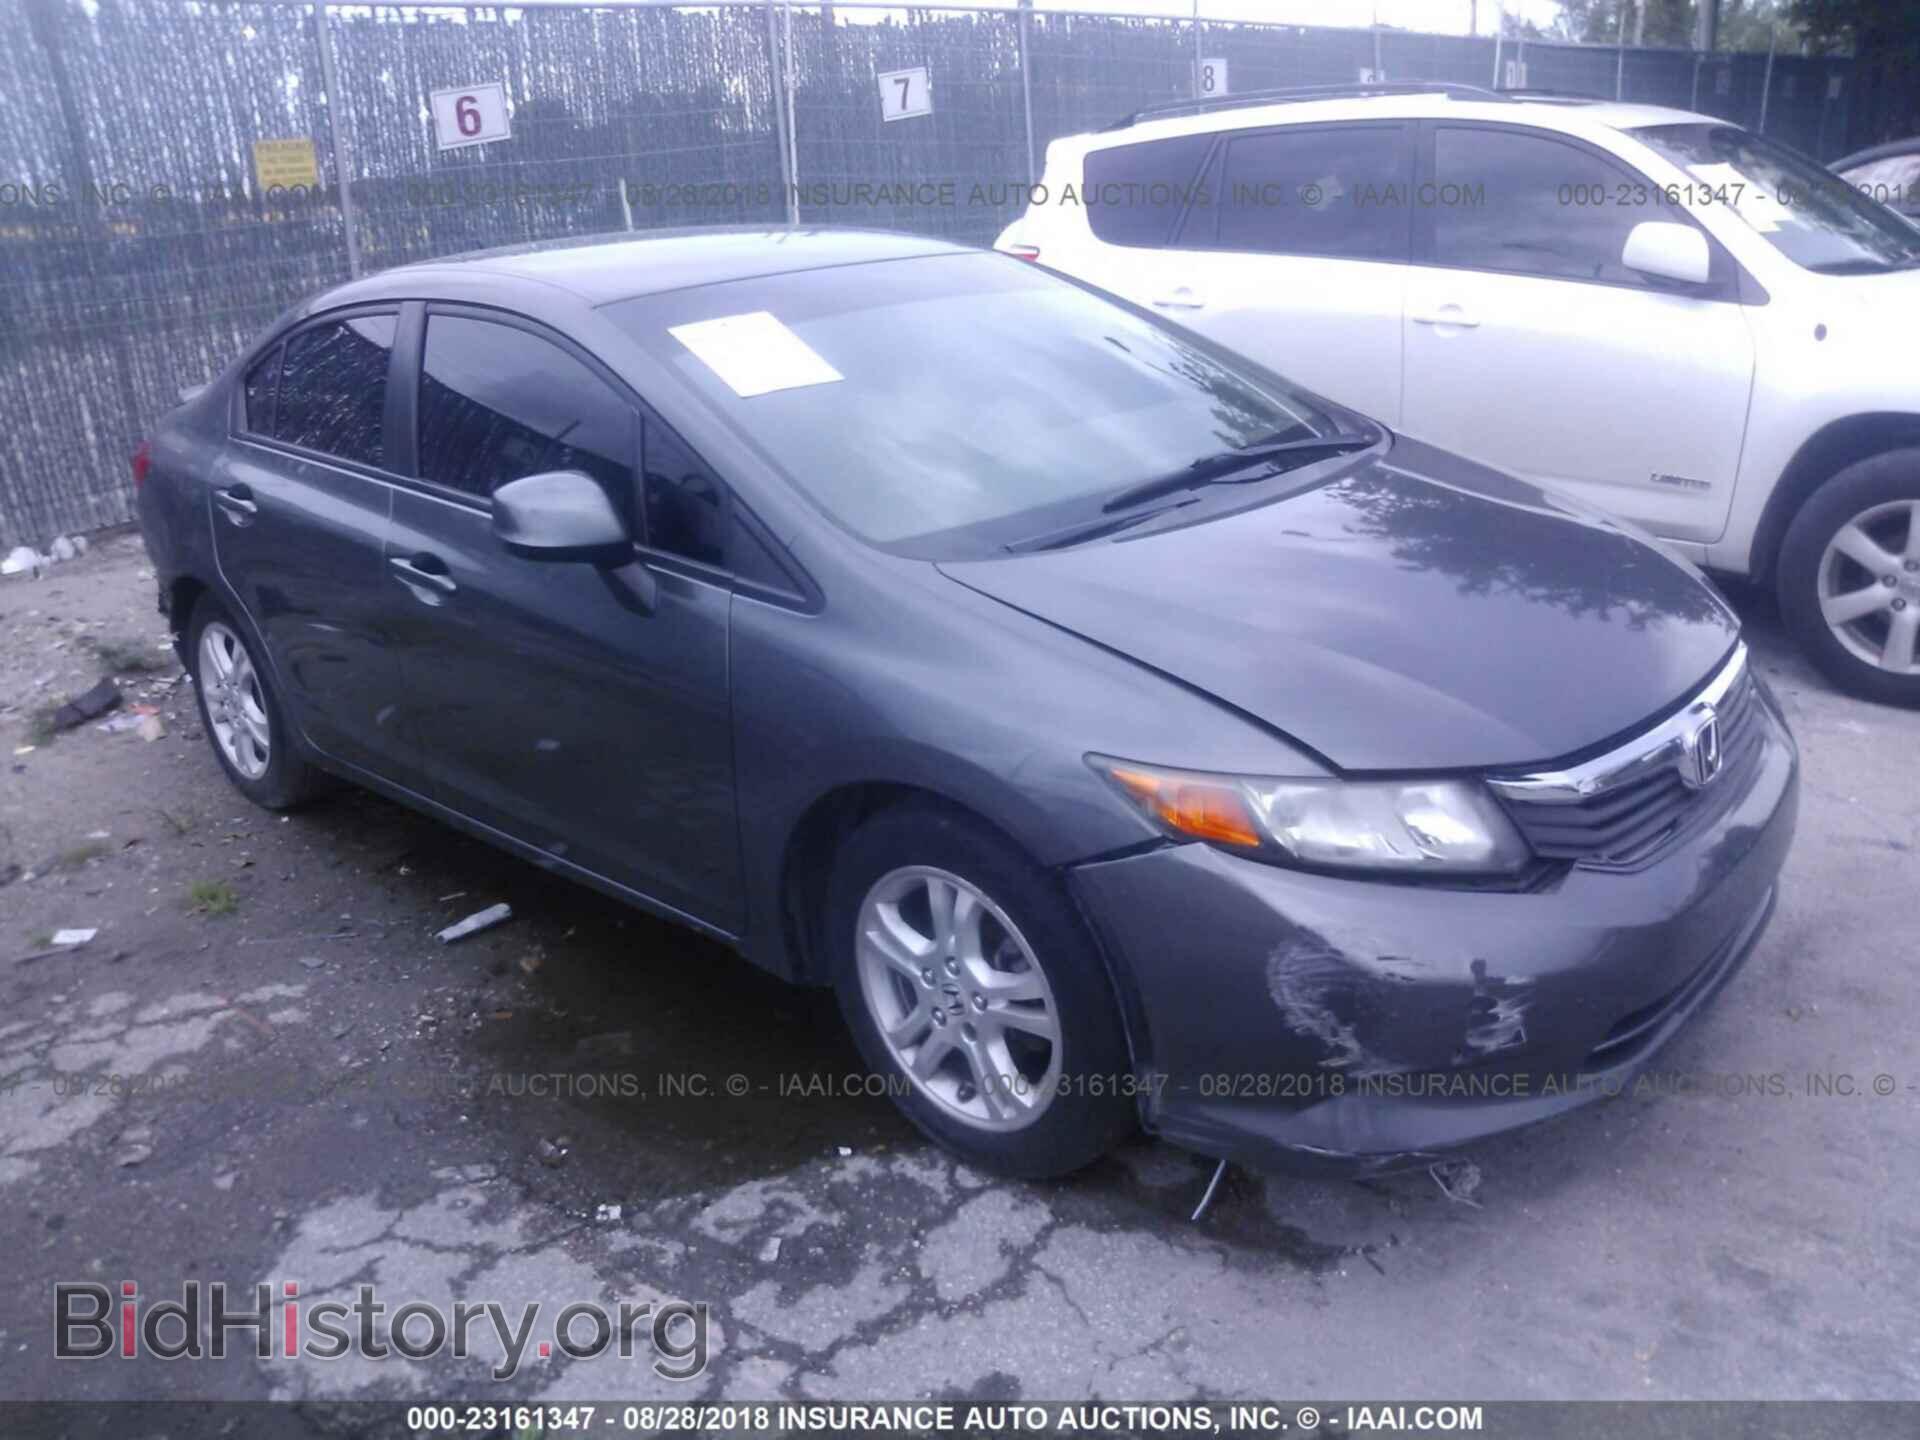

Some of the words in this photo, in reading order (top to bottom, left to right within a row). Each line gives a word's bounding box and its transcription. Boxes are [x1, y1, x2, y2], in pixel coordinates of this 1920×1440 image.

[894, 78, 910, 110] 7
[1204, 65, 1214, 92] 8
[456, 96, 481, 136] 6
